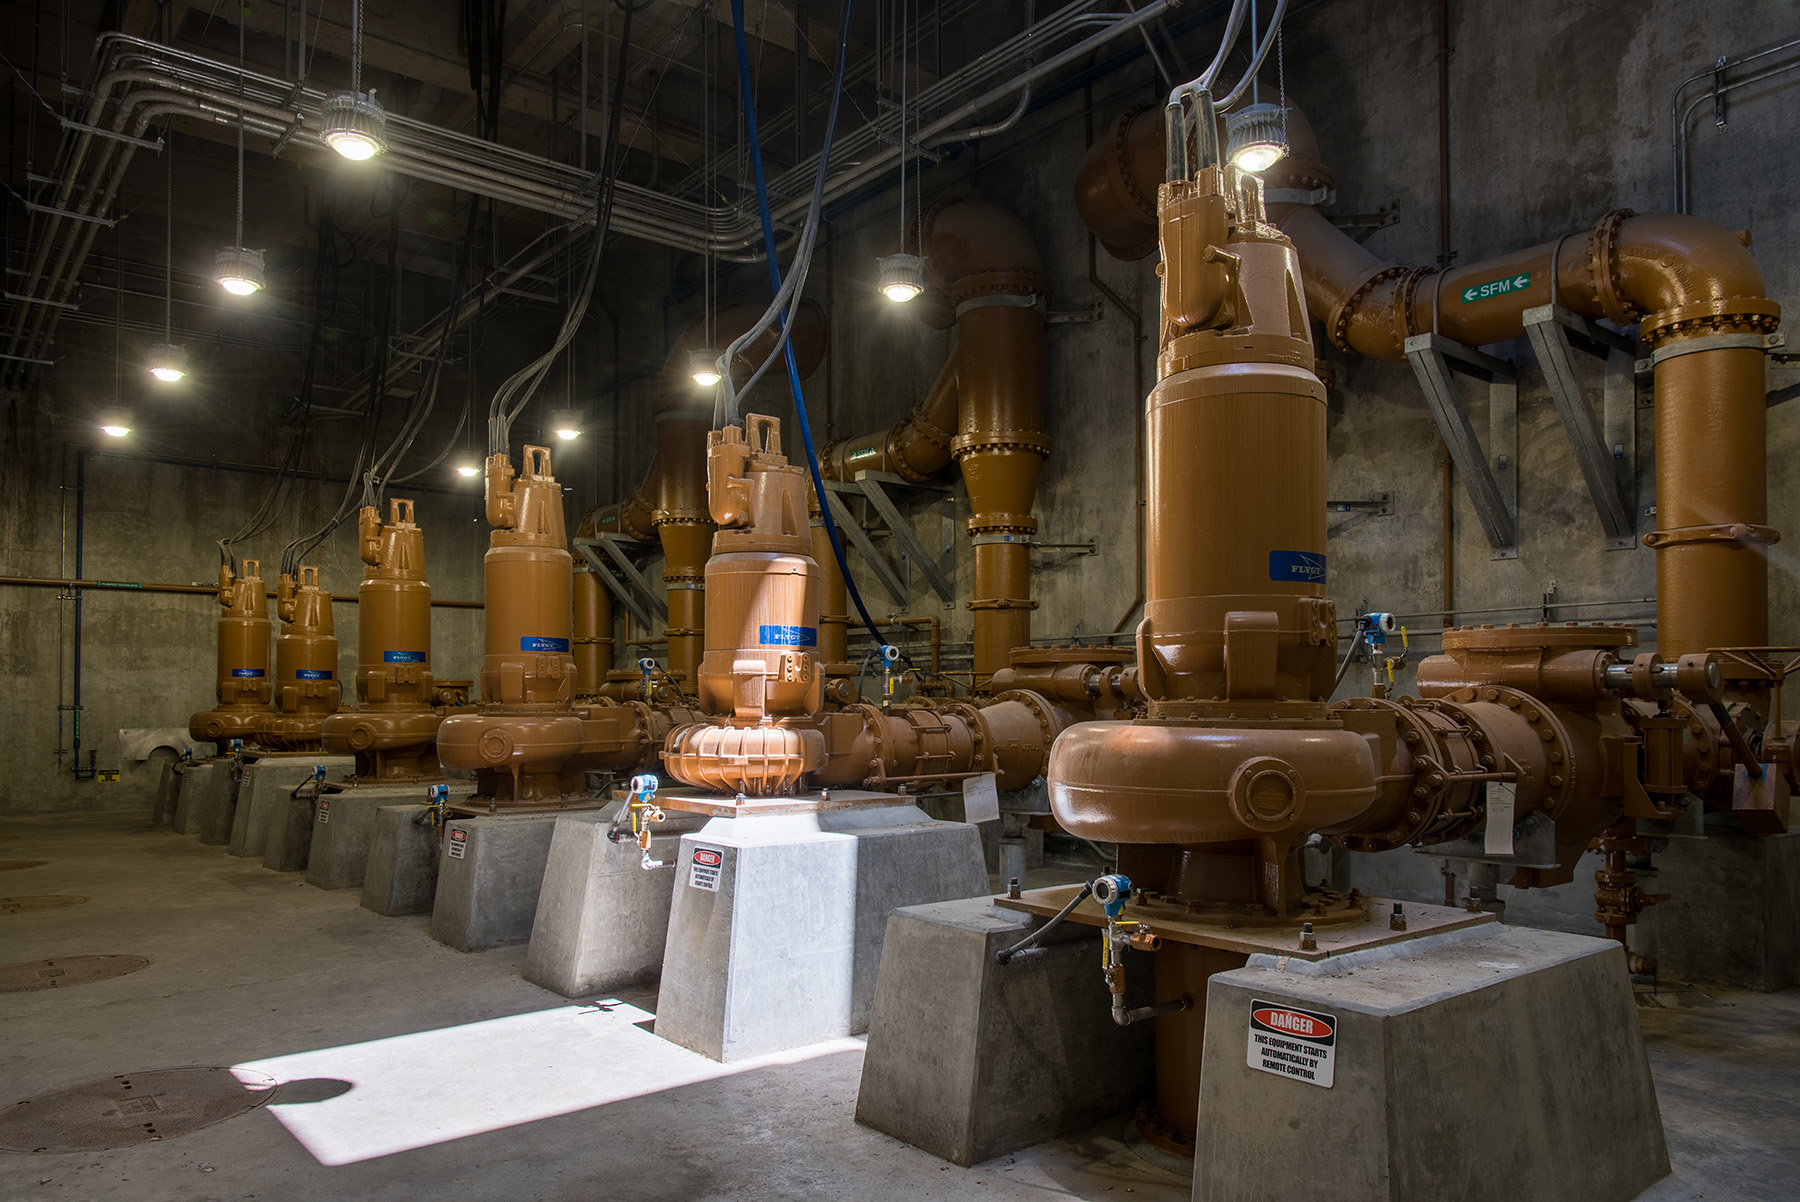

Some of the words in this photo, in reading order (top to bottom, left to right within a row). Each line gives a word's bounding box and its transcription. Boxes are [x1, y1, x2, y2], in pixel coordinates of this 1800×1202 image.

[1480, 279, 1510, 297] SFM
[1291, 565, 1320, 575] FLYGT
[774, 633, 801, 641] FLYGT
[1270, 1011, 1313, 1034] DANGER
[1254, 1034, 1268, 1045] THIS
[1269, 1037, 1303, 1053] EQUIPMENT
[1303, 1045, 1328, 1059] STARTS
[1261, 1047, 1309, 1066] AUTOMATICALLY
[1309, 1059, 1318, 1069] BY
[1262, 1059, 1286, 1073] REMOTE
[1286, 1065, 1315, 1080] CONTROL
